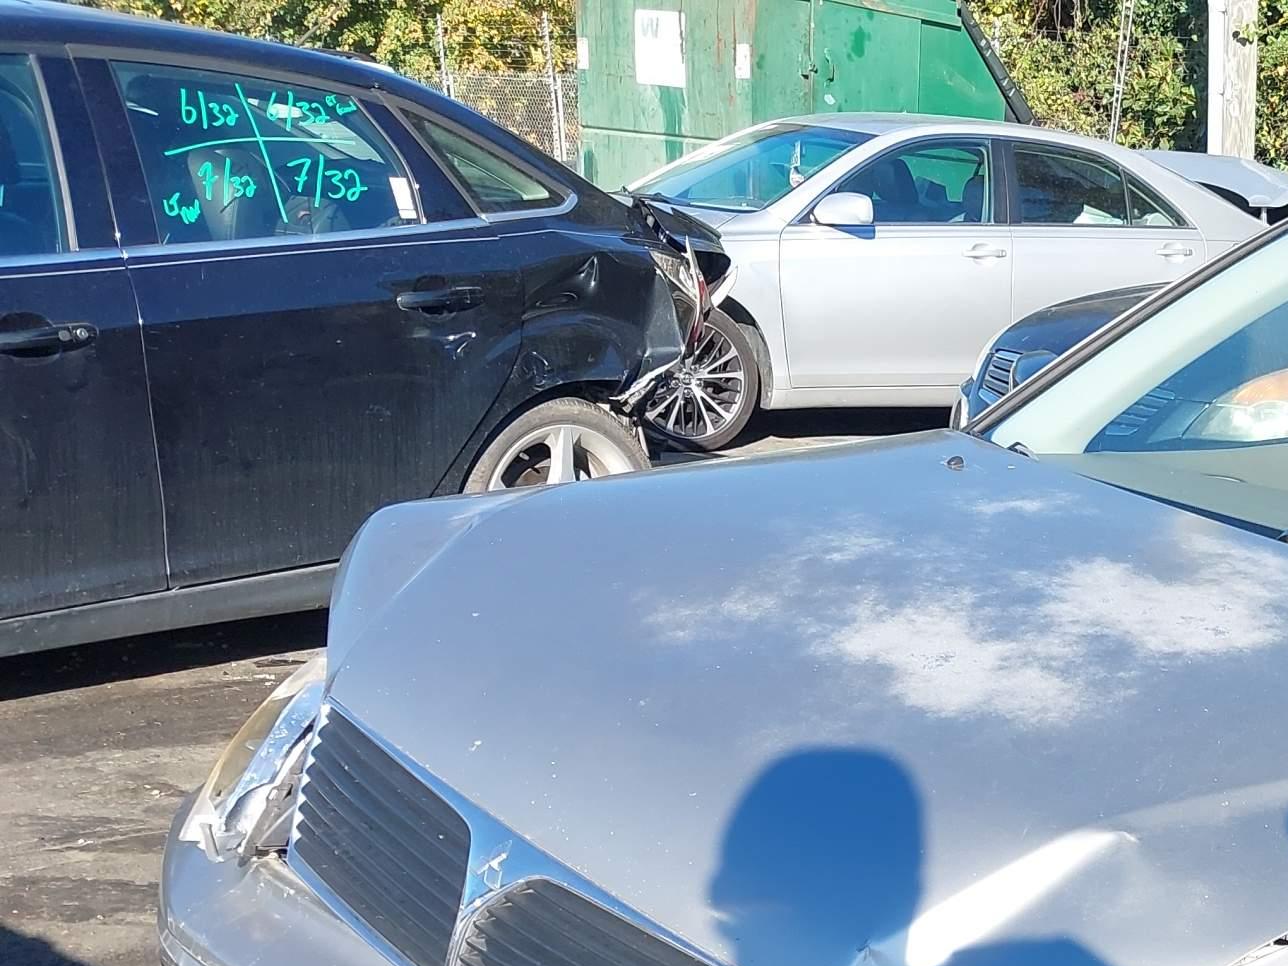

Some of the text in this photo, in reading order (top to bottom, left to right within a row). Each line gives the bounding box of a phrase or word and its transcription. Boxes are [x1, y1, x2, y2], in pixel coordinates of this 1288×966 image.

[179, 87, 239, 130] 6/32
[266, 90, 331, 132] 6/32
[197, 157, 257, 207] 7/32
[286, 153, 368, 208] 7/32
